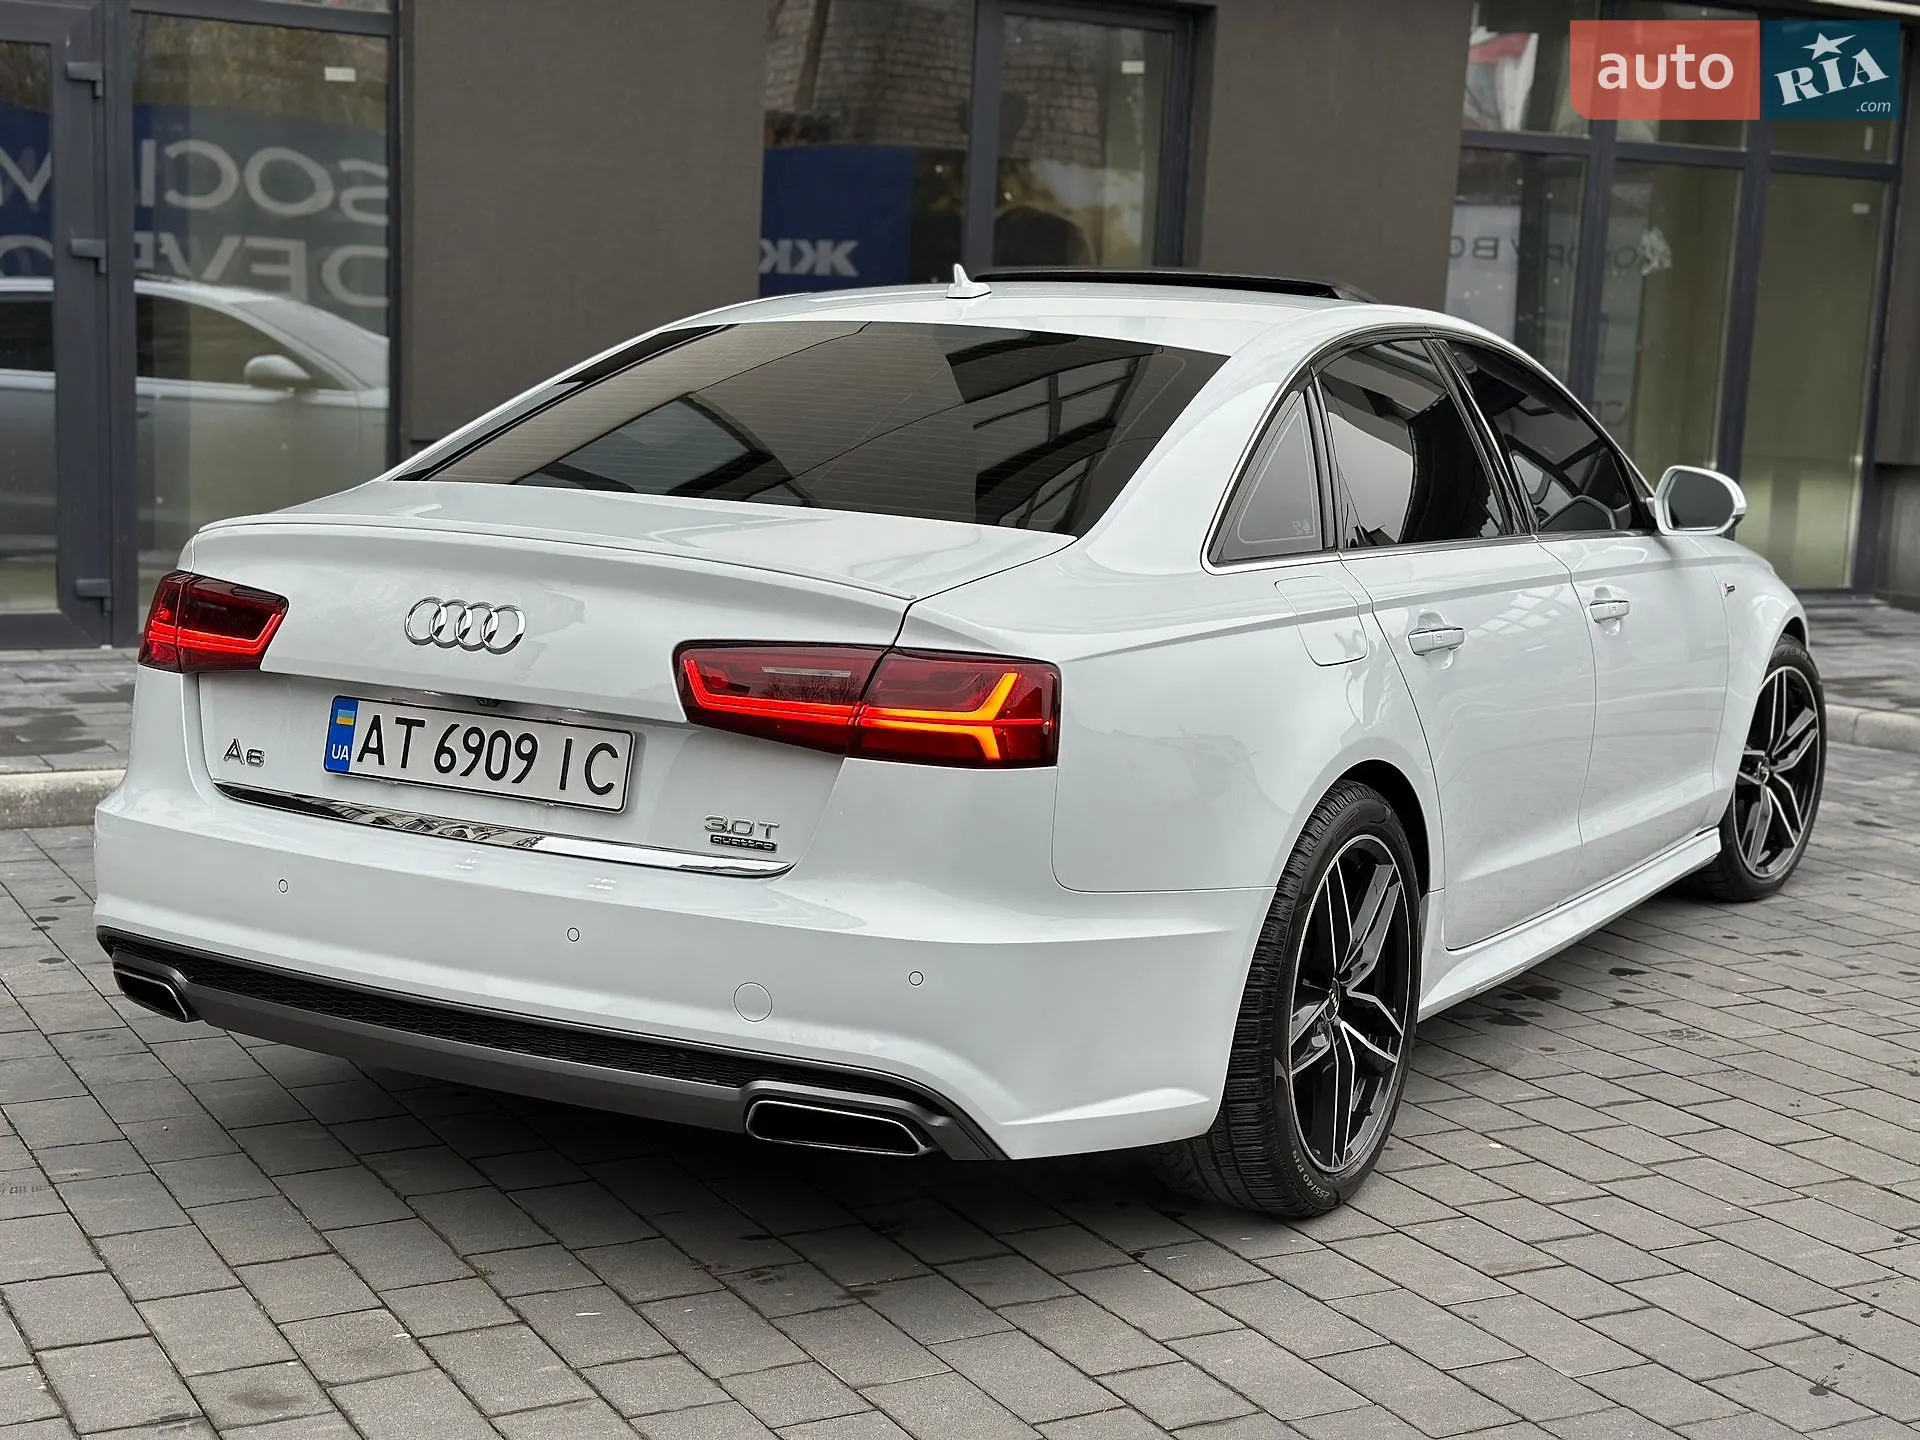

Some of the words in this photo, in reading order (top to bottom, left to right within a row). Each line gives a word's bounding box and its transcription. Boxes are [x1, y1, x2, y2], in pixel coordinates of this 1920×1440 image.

[223, 737, 265, 767] A6
[331, 743, 349, 761] UA
[357, 714, 426, 769] AT
[433, 723, 538, 784] 6909
[559, 738, 619, 796] IC
[712, 835, 773, 850] quattro
